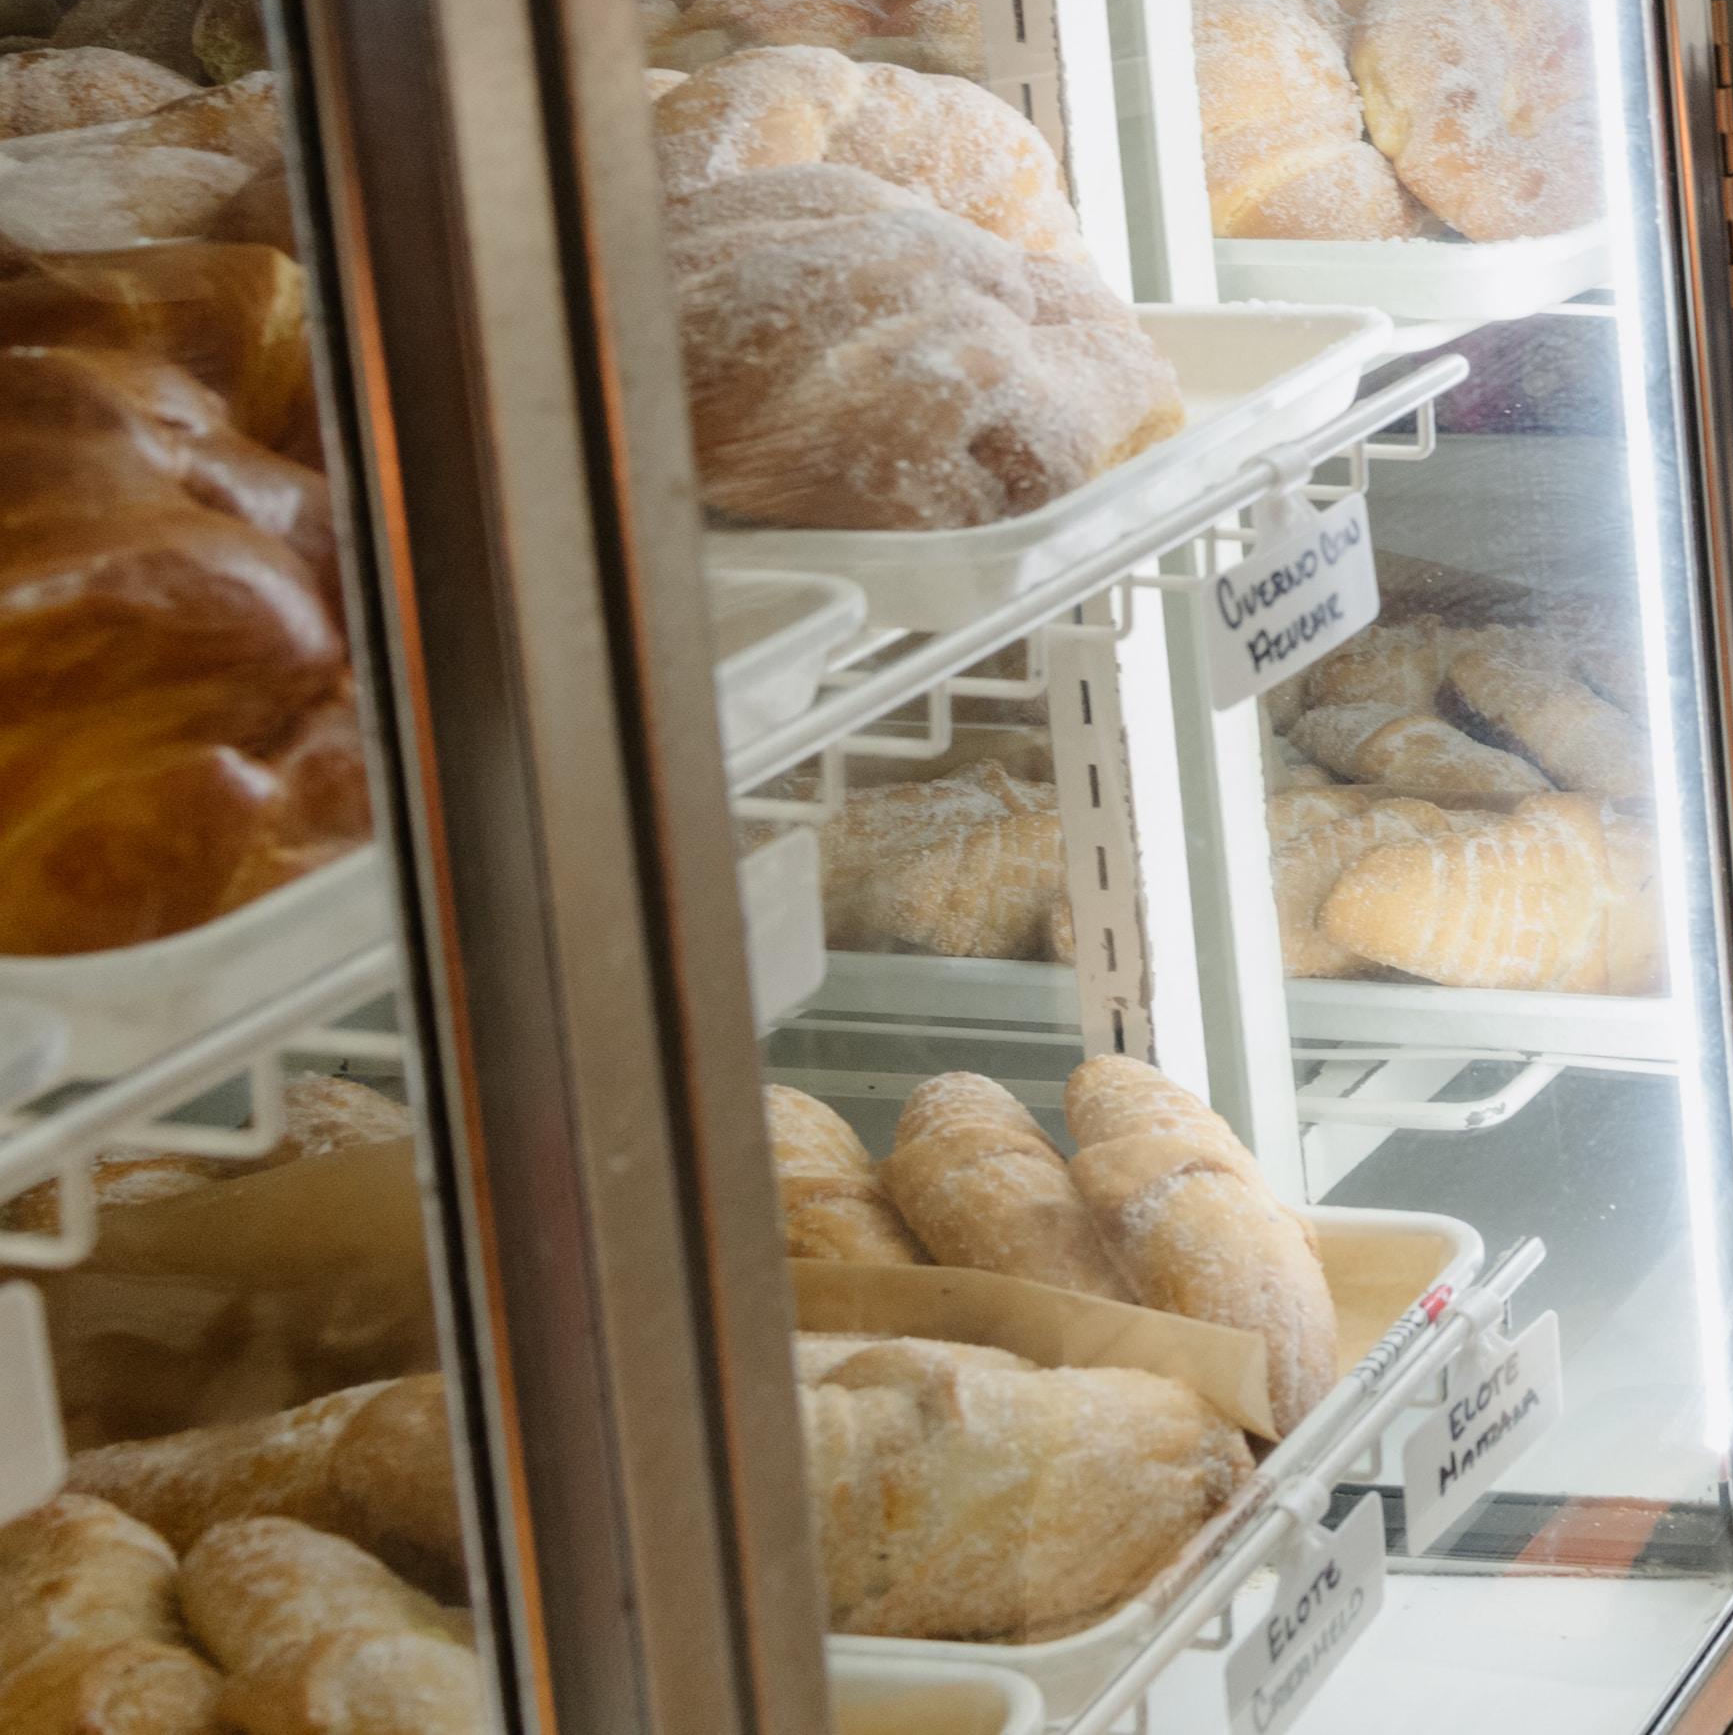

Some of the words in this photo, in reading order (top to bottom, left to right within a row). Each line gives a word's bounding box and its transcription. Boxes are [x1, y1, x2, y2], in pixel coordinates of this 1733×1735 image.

[1216, 550, 1318, 630] CUERNO
[1320, 517, 1361, 565] CON
[1449, 1352, 1520, 1442] ELOTE
[1267, 1559, 1342, 1664] ELOTE
